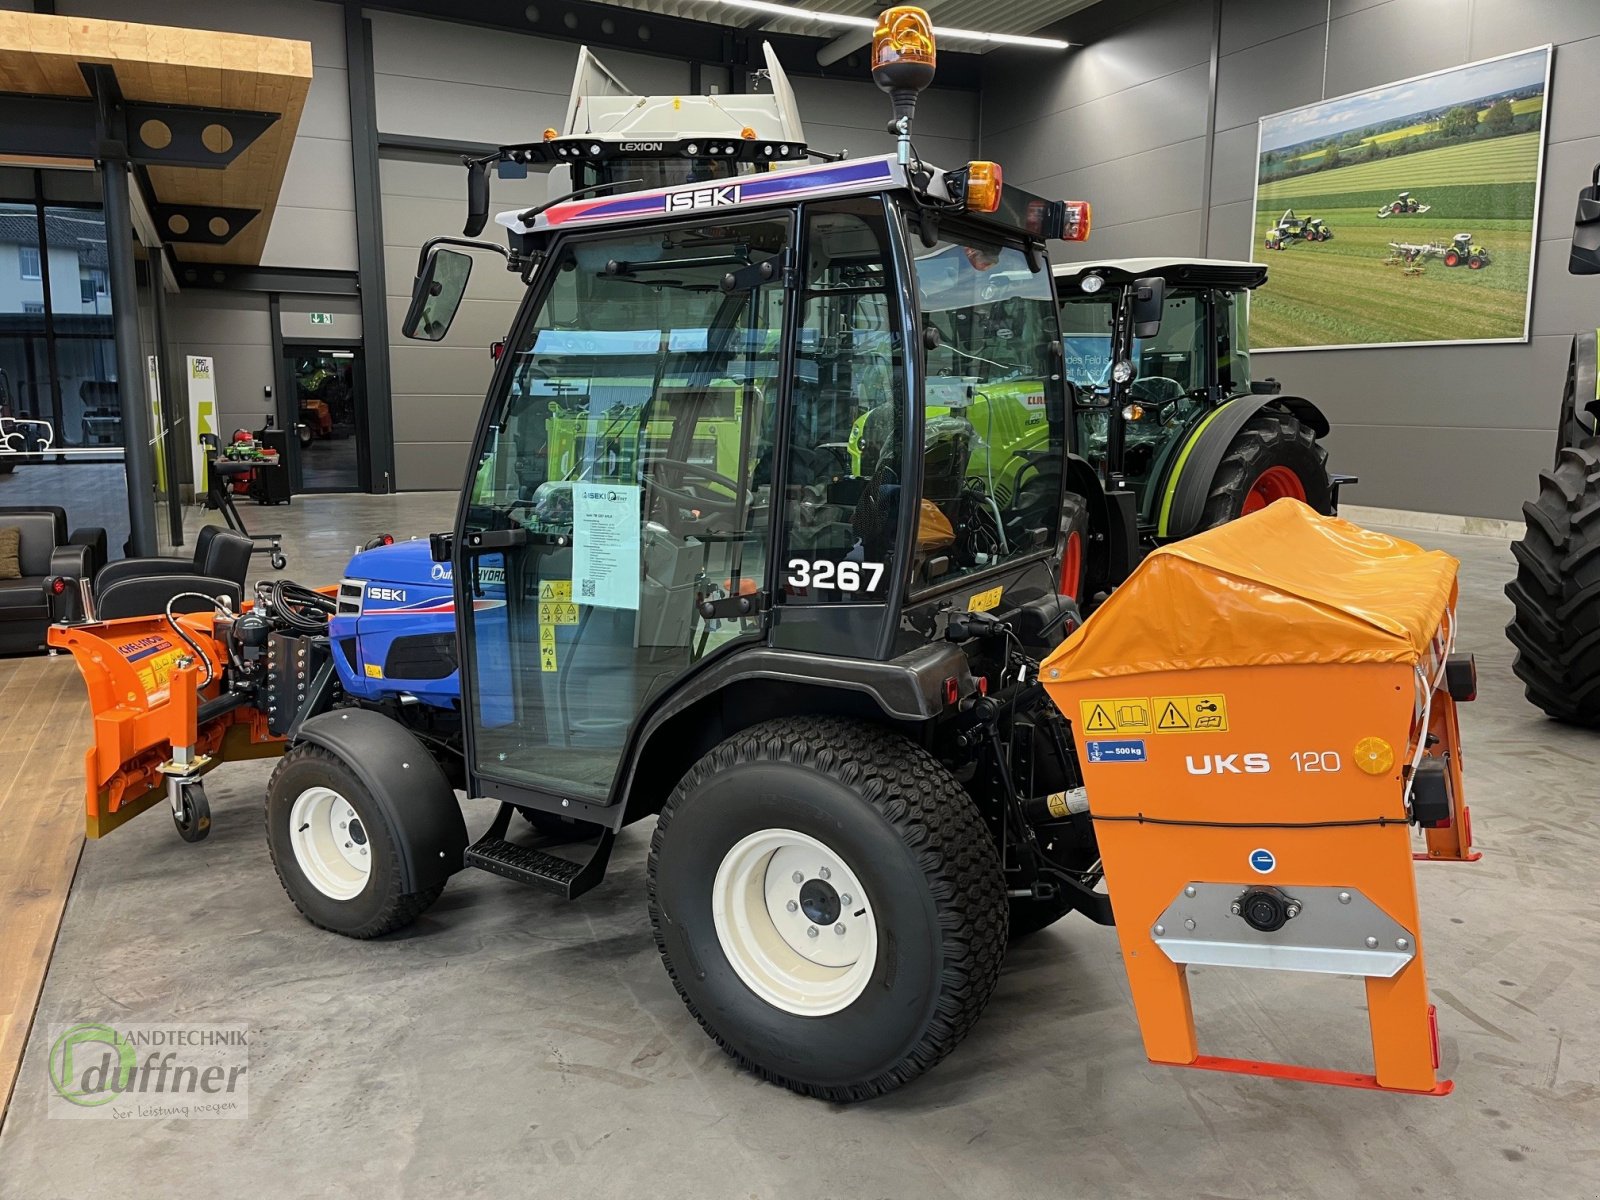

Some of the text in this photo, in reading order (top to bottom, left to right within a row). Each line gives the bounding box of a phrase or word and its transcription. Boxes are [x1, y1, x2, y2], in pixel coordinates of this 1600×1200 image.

[619, 142, 663, 152] LEXION
[665, 185, 741, 212] ISEKI
[787, 558, 884, 592] 3267
[367, 586, 406, 602] ISEKI
[1115, 747, 1130, 755] 500
[1130, 747, 1142, 756] kg
[1185, 751, 1341, 775] UKS 120
